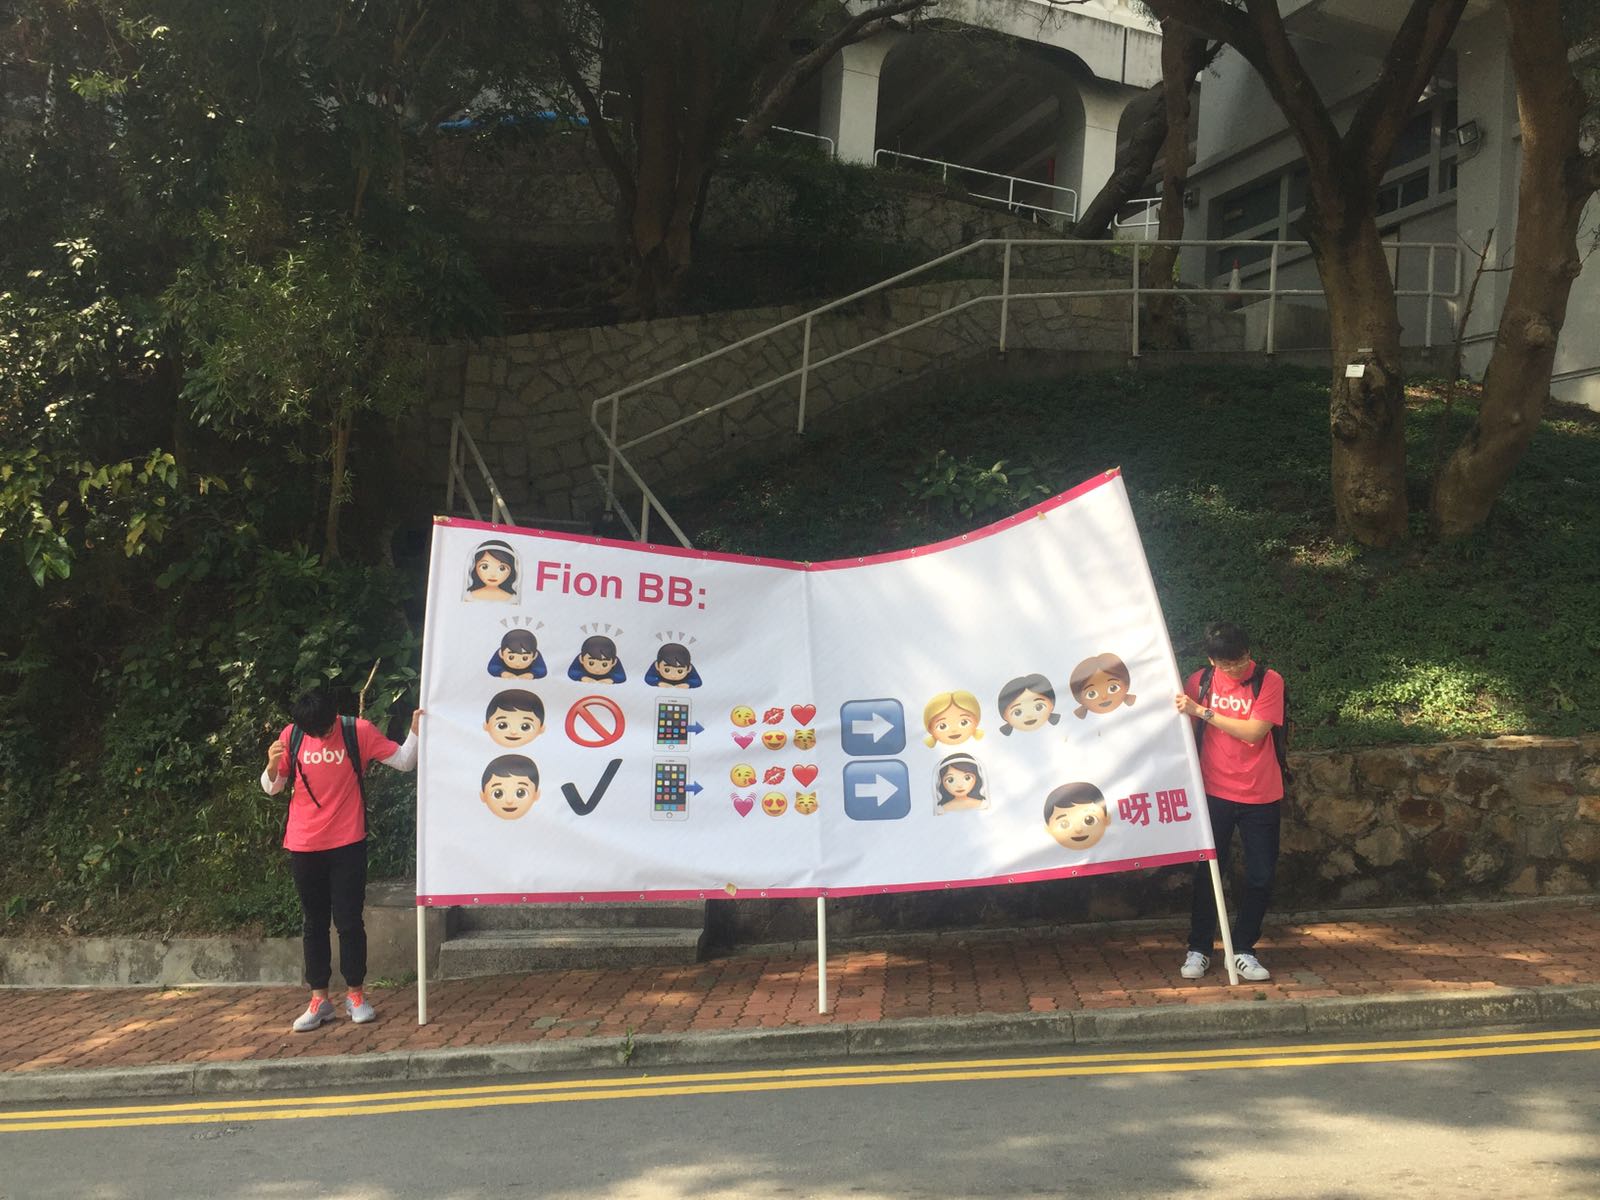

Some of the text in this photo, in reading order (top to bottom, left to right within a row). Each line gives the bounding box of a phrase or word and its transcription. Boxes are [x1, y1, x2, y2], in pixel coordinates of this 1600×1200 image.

[536, 561, 706, 609] Fion BB:
[1211, 693, 1252, 715] toby
[303, 748, 345, 764] toby
[1117, 788, 1192, 826] 呀肥
